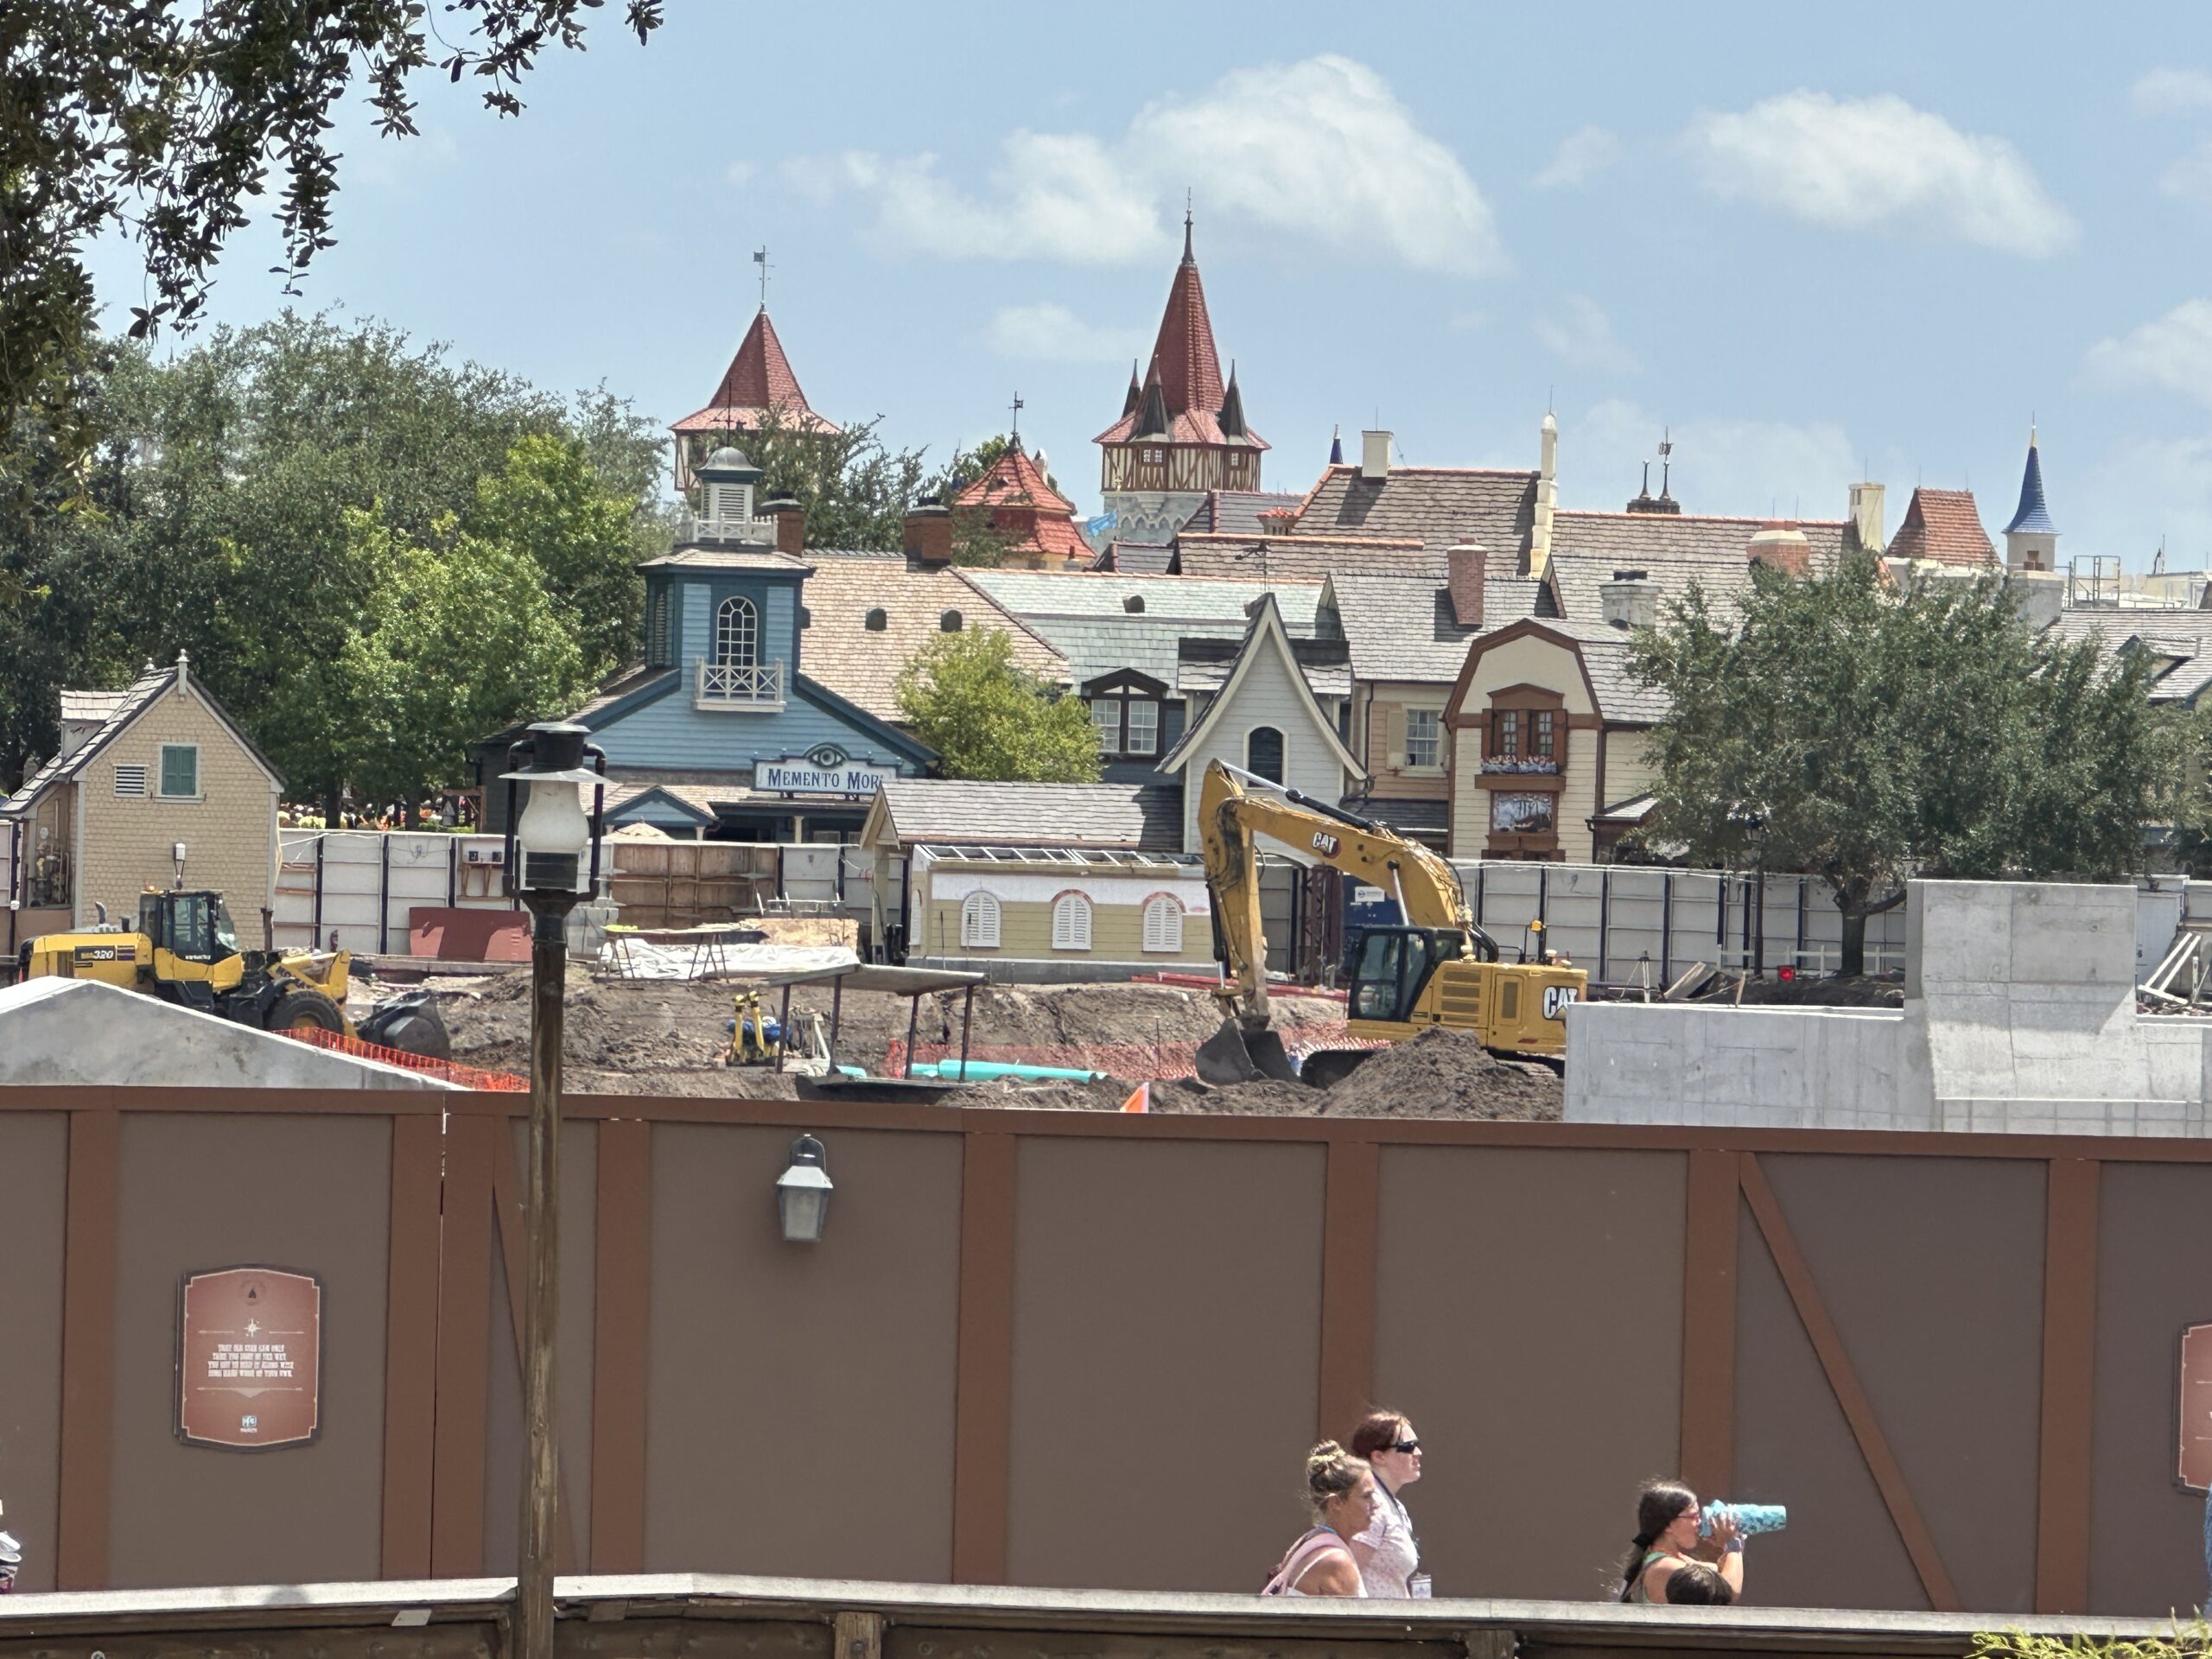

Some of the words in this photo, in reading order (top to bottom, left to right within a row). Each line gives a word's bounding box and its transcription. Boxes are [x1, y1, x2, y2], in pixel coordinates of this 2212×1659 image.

[768, 768, 840, 788] MEMENTO
[847, 772, 883, 790] MOR
[1313, 831, 1338, 854] CAT
